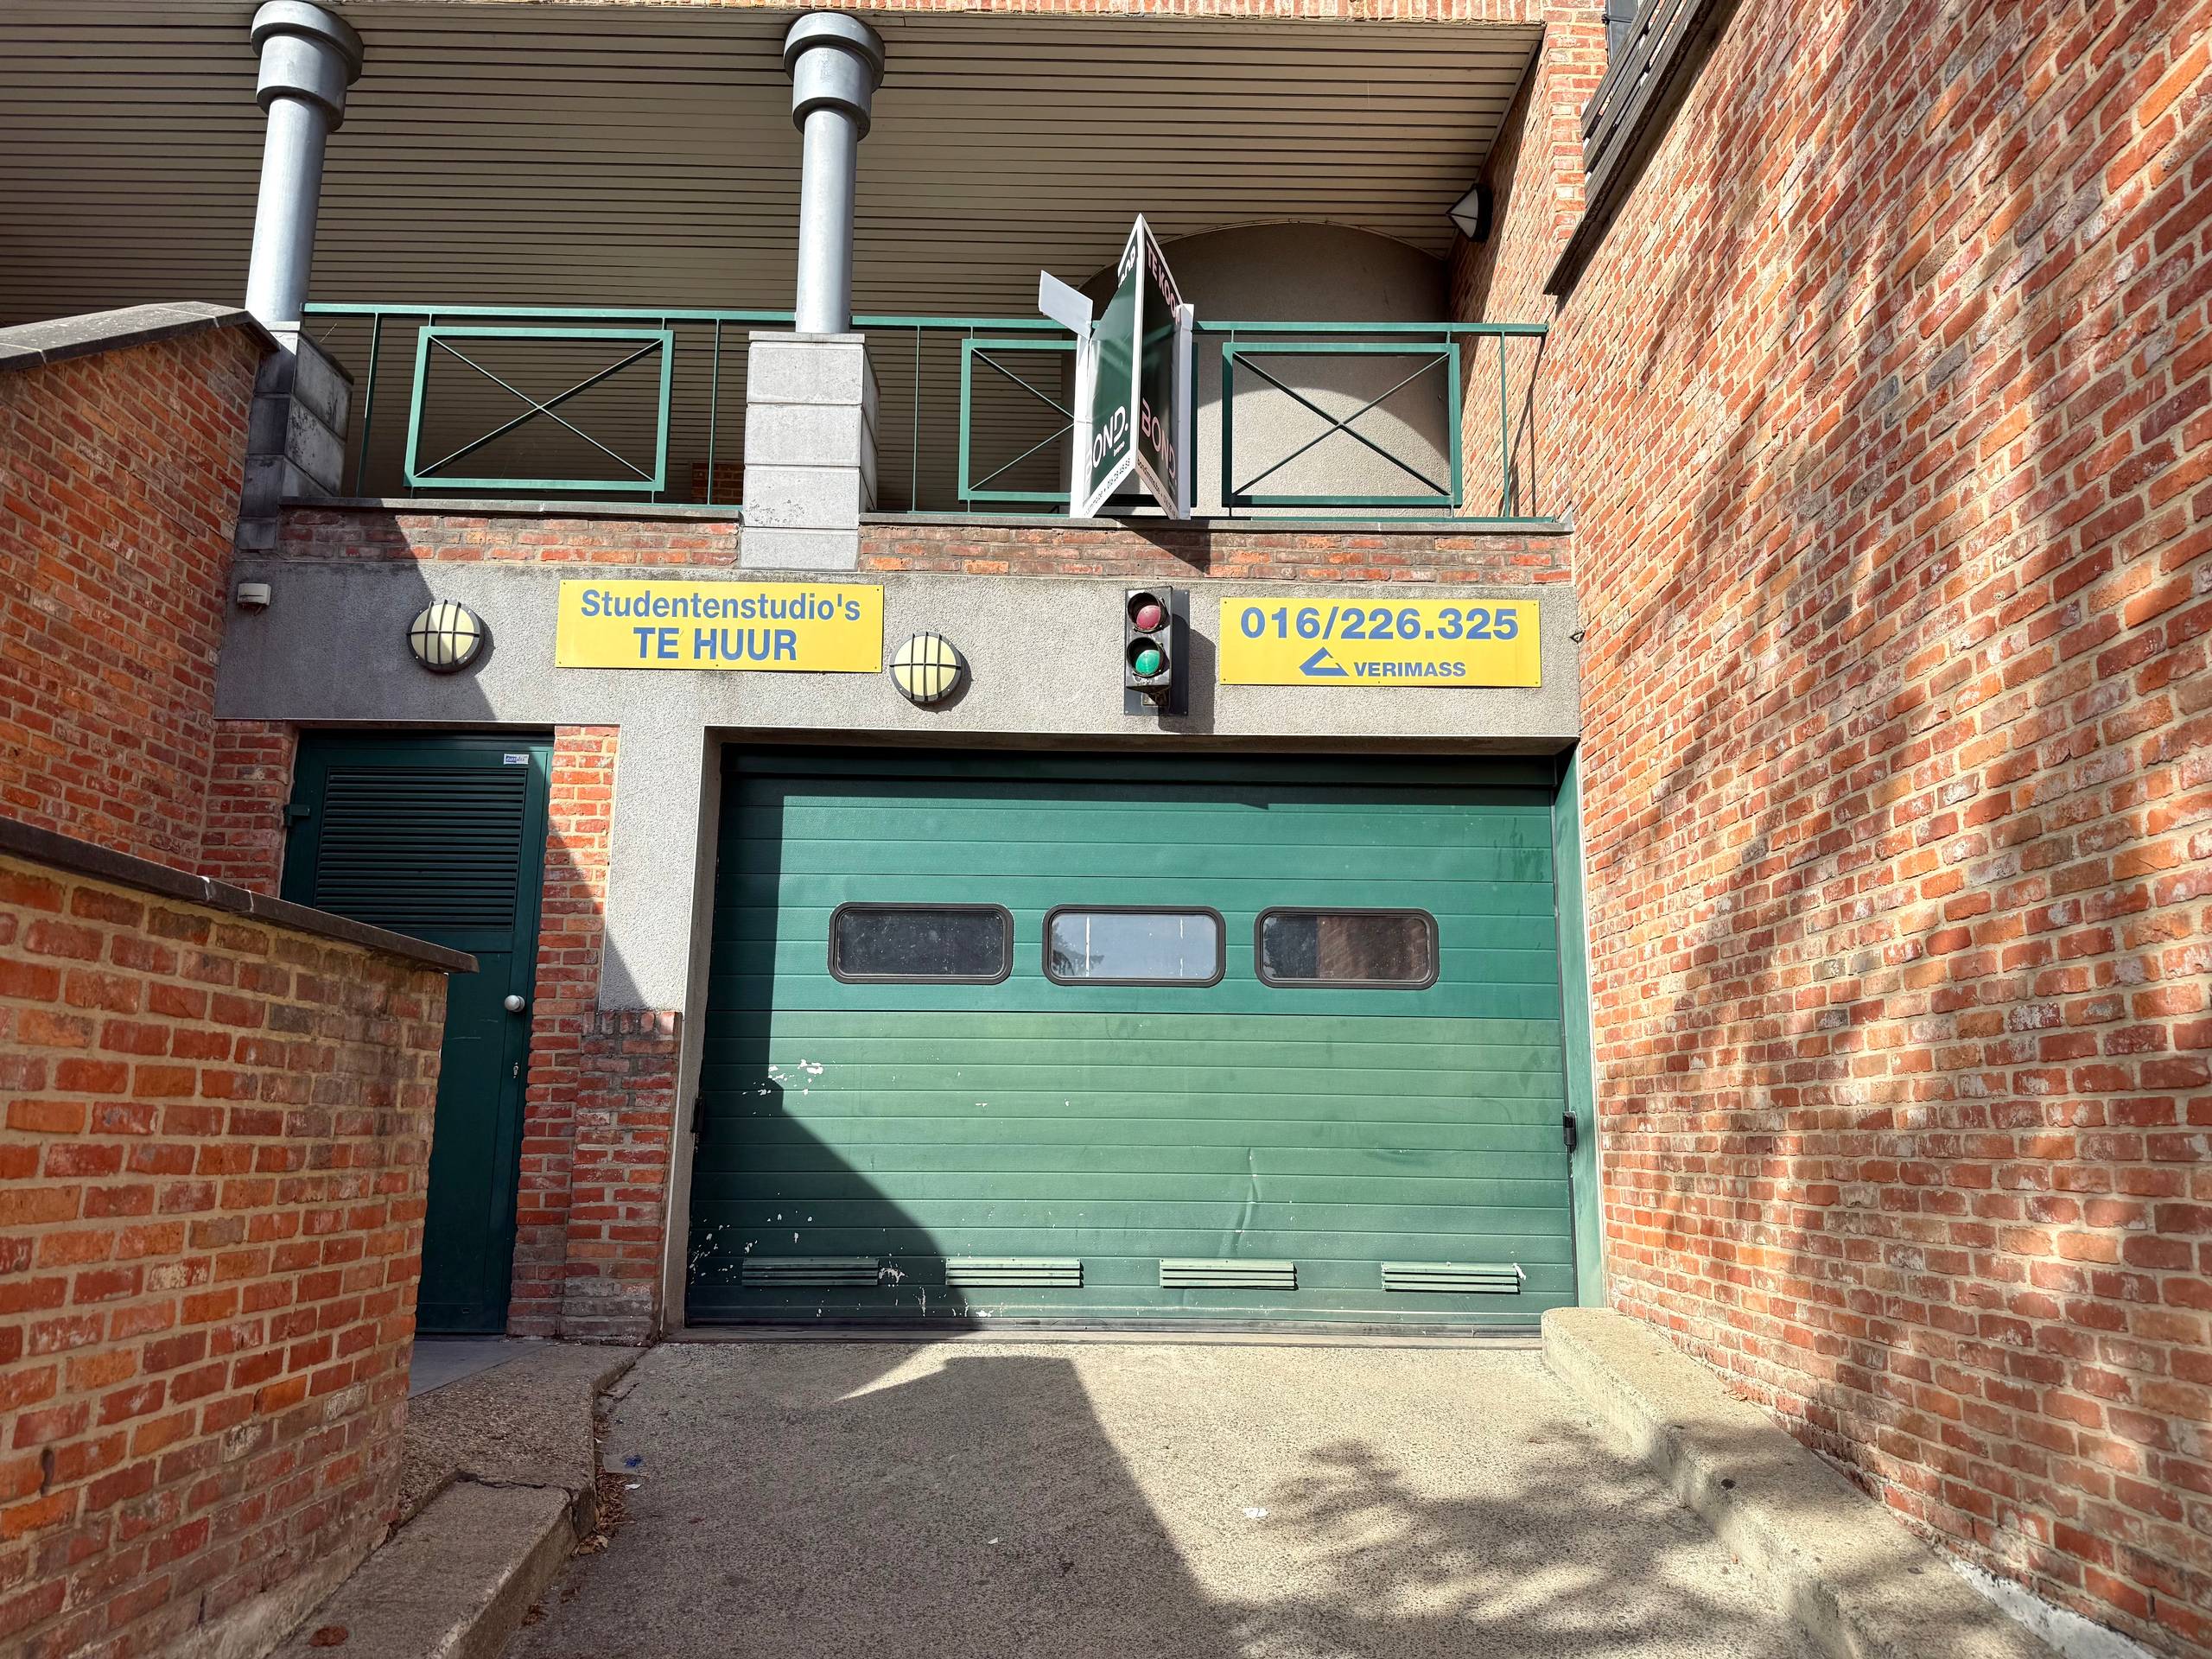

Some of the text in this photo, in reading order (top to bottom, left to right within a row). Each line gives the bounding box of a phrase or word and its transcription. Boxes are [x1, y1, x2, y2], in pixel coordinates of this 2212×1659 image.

[1147, 240, 1158, 282] TE
[581, 589, 861, 621] Studentenstudio's
[1241, 607, 1518, 641] 016/226.325
[632, 627, 797, 661] TE HUUR
[1353, 662, 1466, 677] VERIMASS
